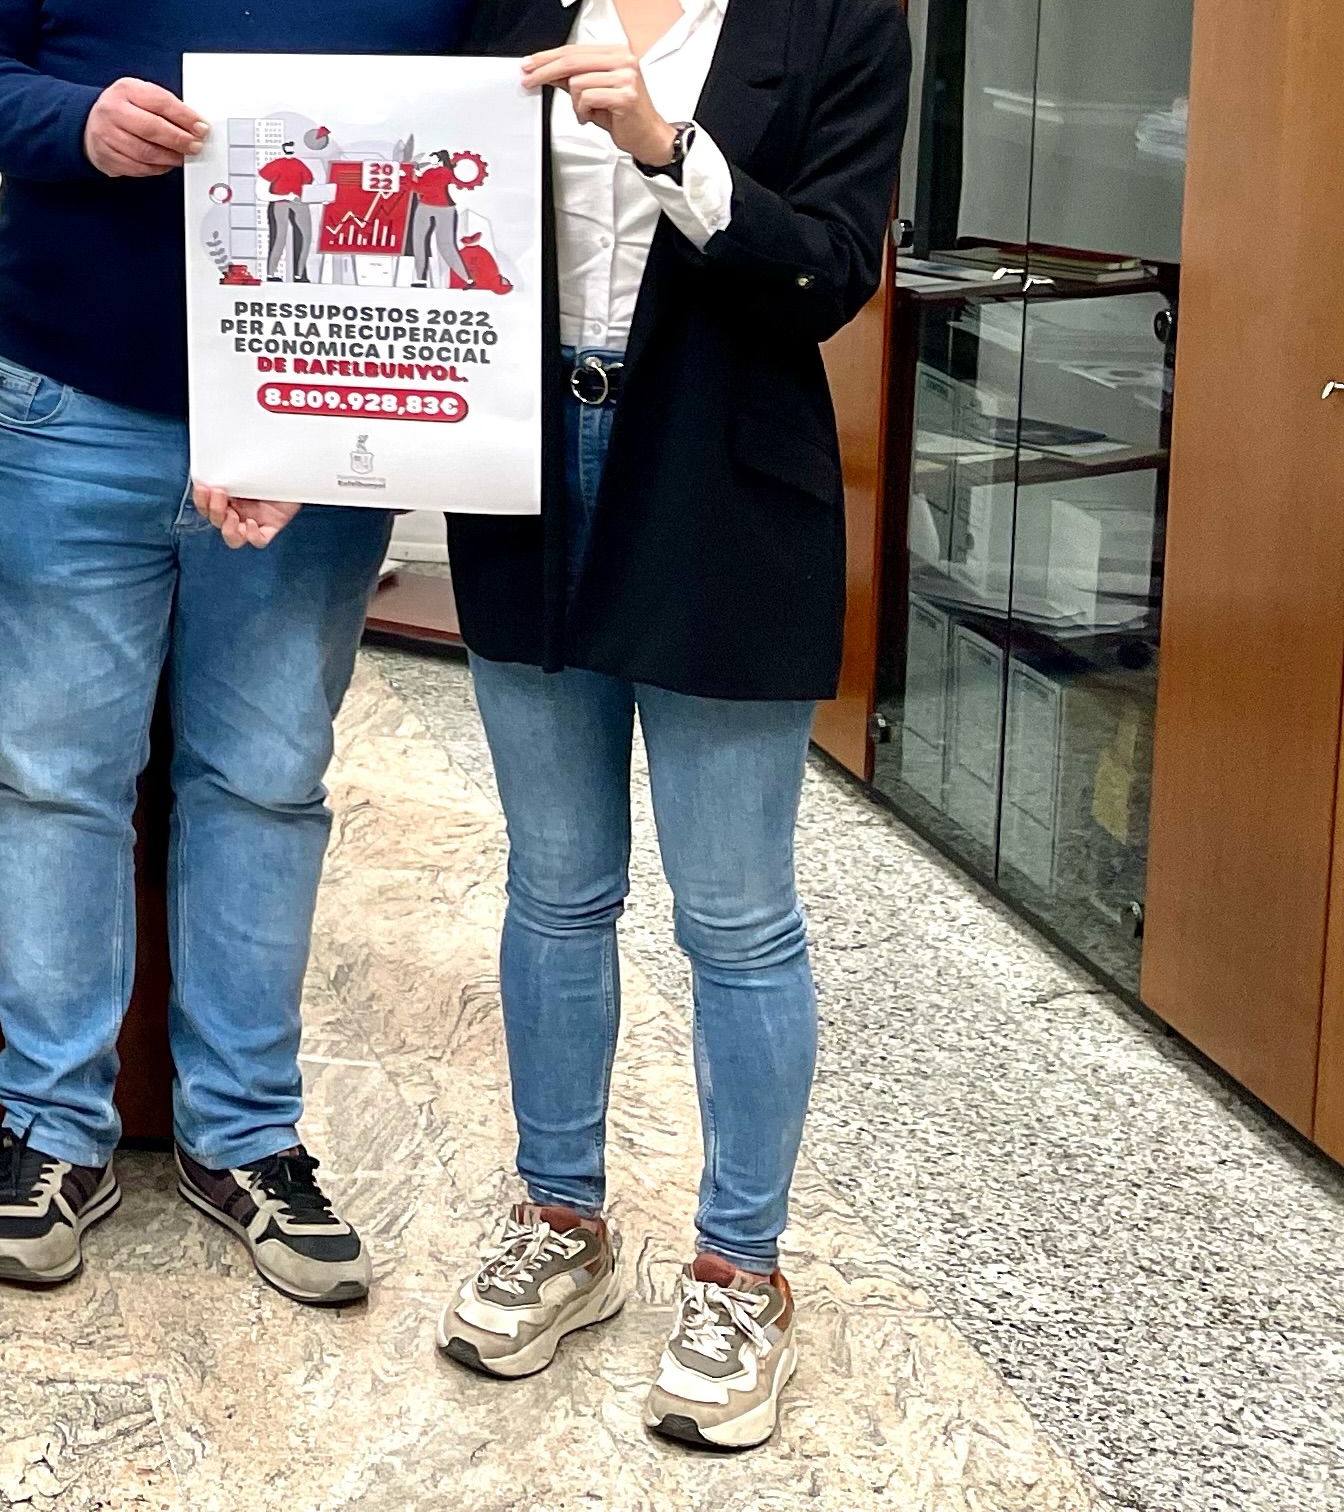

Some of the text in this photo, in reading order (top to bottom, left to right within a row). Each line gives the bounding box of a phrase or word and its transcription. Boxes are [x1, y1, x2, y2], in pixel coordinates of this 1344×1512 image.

[369, 163, 393, 176] 20
[369, 177, 393, 190] 22
[235, 302, 419, 323] PRESSUPOSTOS
[221, 319, 263, 335] PER
[271, 321, 286, 336] A
[294, 322, 321, 338] LA
[389, 345, 394, 359] I
[403, 345, 490, 364] SOCIAL
[258, 357, 468, 382] DE RAFELBUNYOL.
[265, 388, 459, 415] 8.809.928,83€
